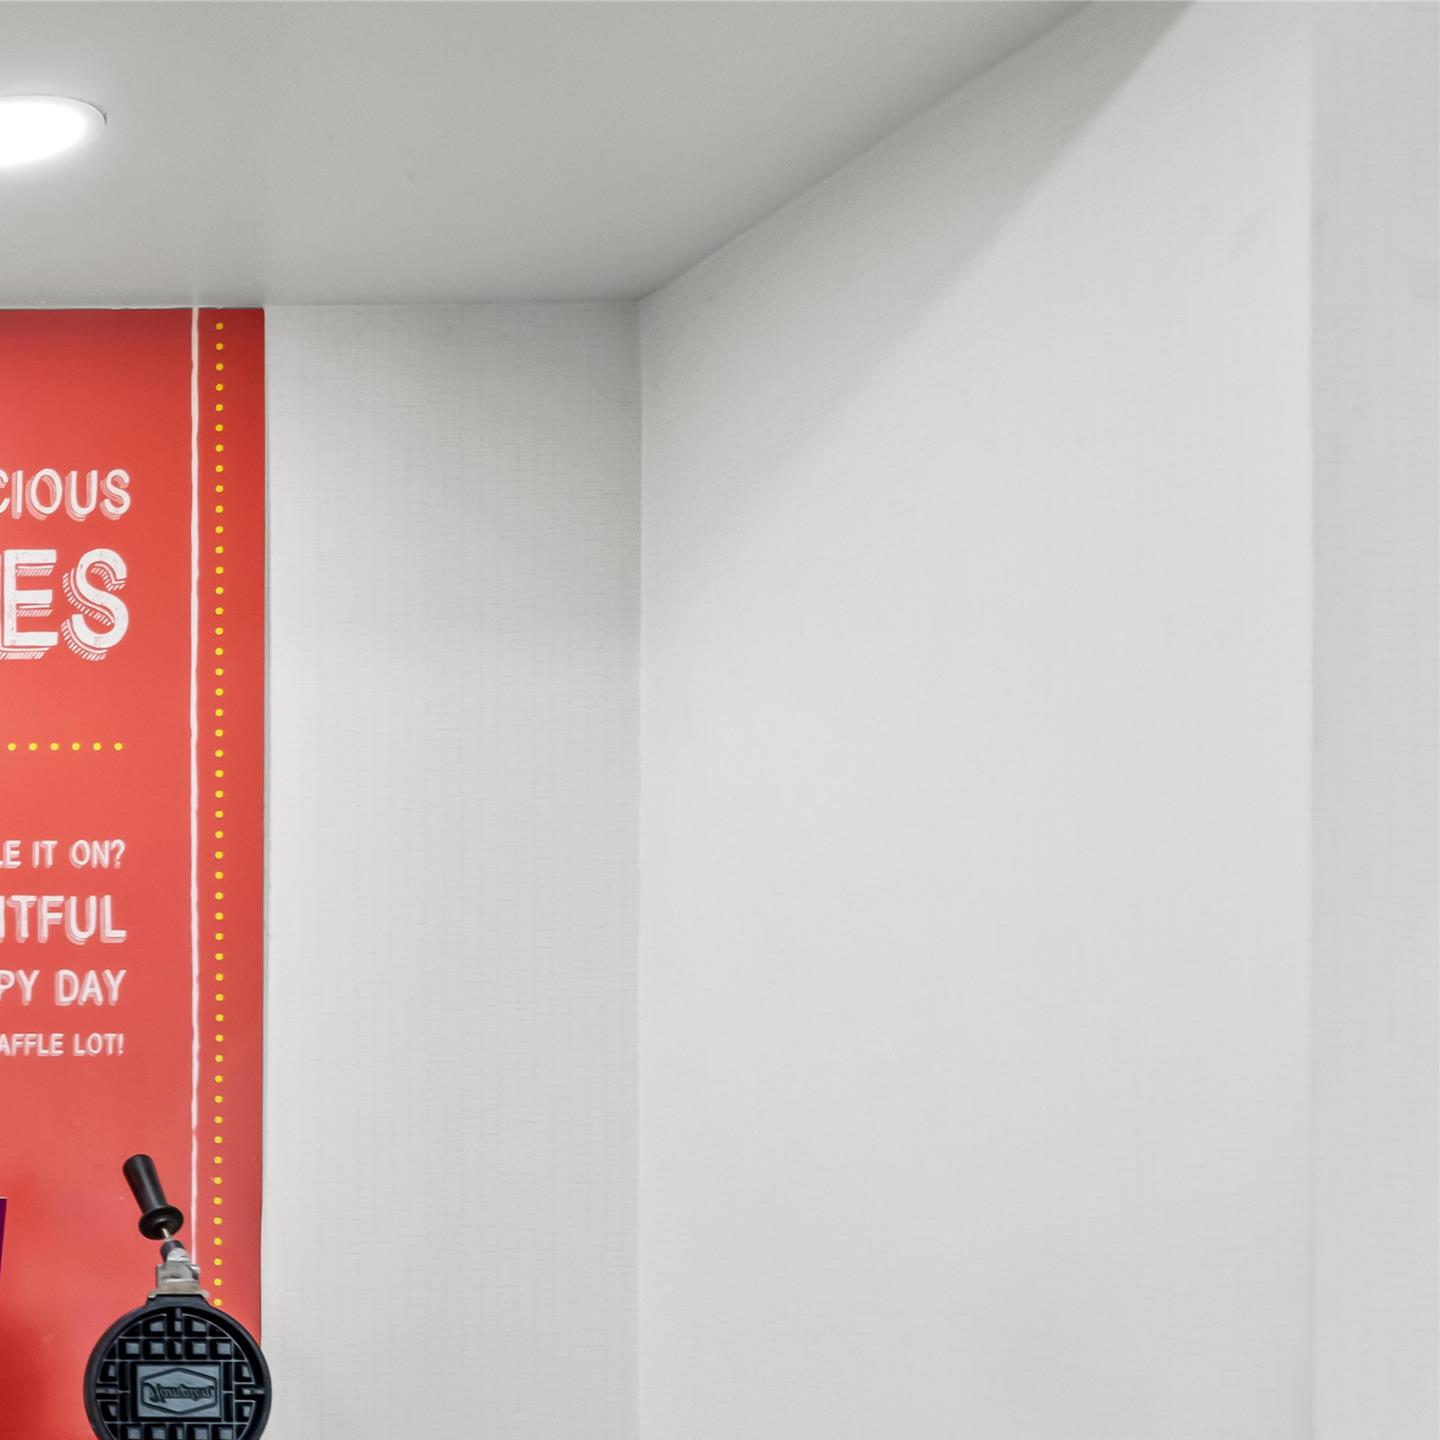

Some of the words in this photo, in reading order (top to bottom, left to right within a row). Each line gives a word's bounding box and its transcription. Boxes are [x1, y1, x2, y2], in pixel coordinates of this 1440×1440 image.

[32, 839, 58, 869] IT
[69, 839, 126, 869] ON?
[54, 969, 127, 1006] DAY
[73, 1033, 125, 1056] LOT!
